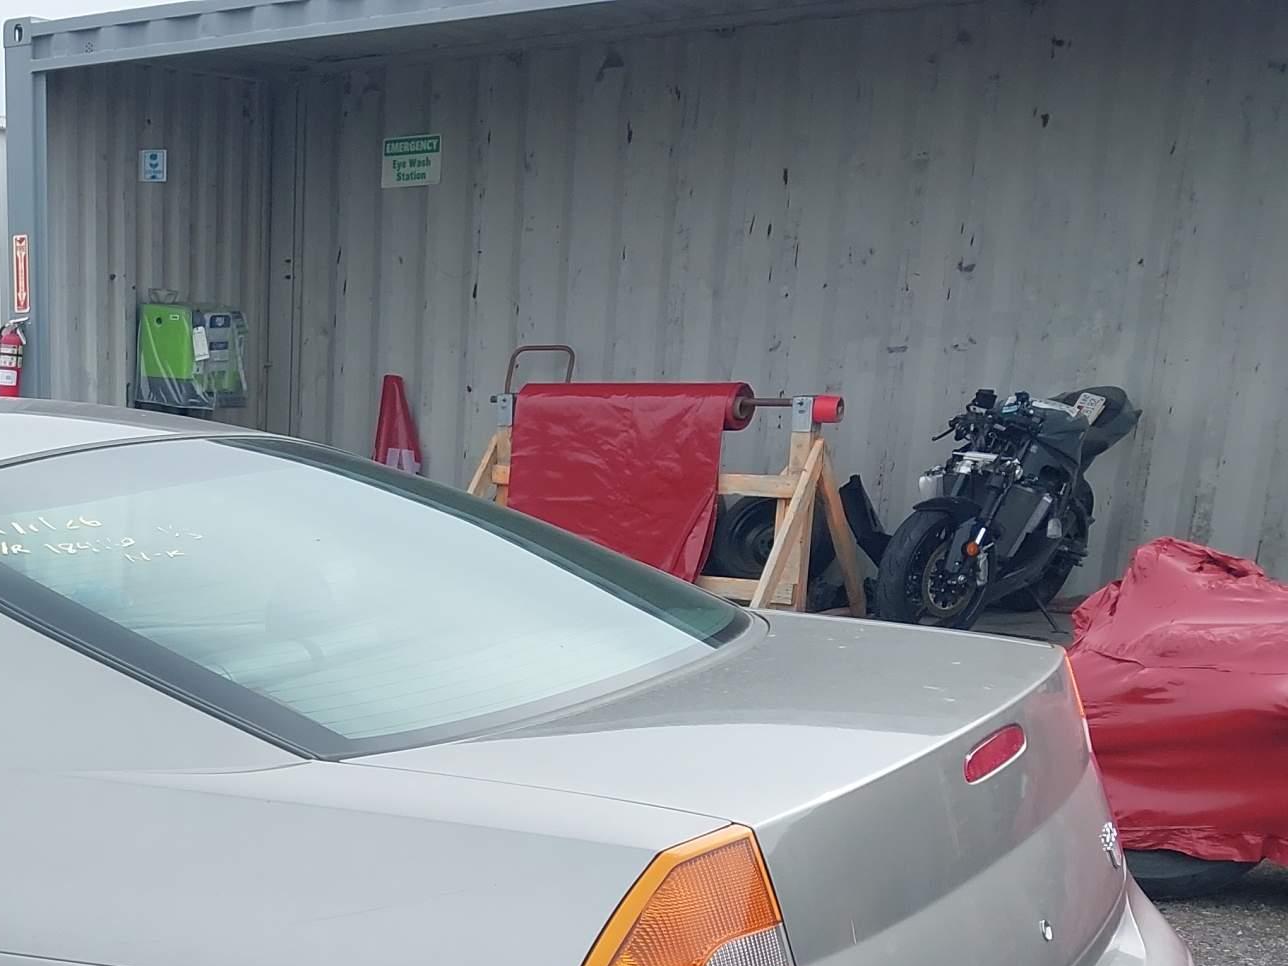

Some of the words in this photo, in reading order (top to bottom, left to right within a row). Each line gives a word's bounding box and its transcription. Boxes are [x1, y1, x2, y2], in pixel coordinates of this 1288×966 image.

[386, 139, 439, 154] EMERGENCY
[392, 159, 407, 172] Eye
[409, 156, 432, 168] Wash
[396, 172, 426, 181] Station
